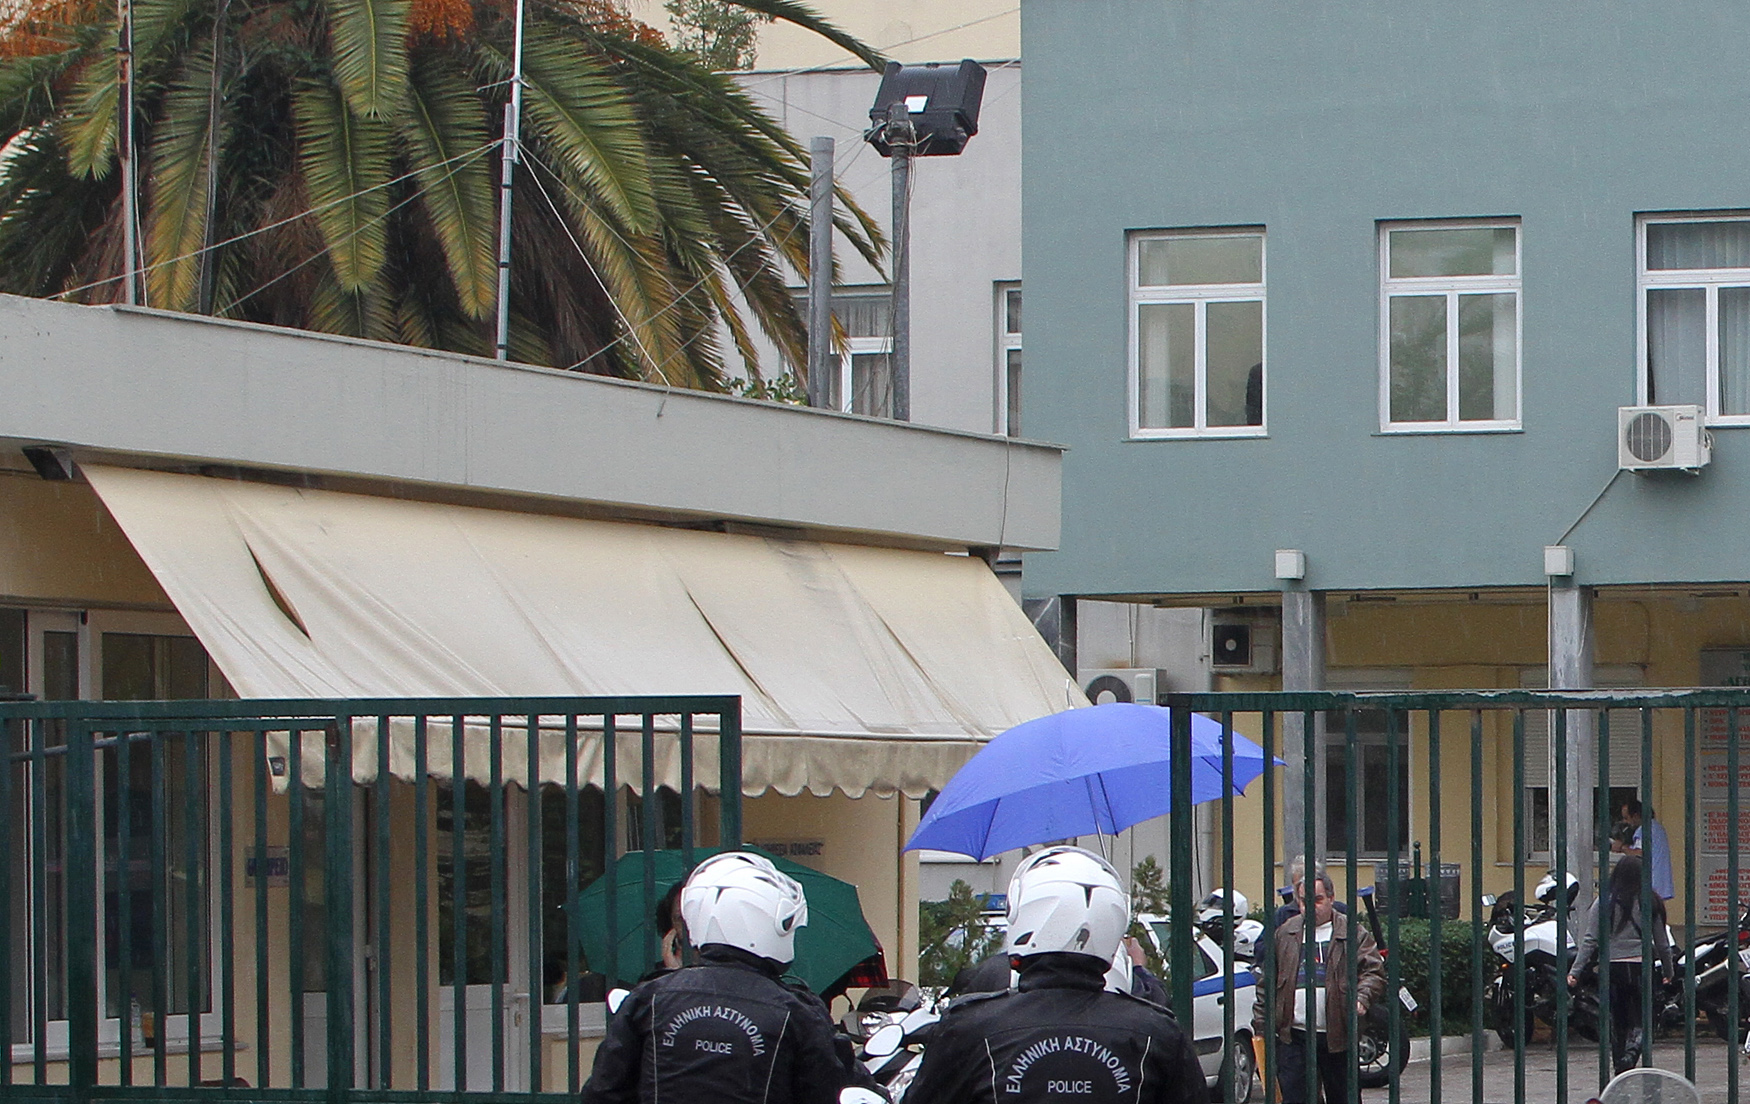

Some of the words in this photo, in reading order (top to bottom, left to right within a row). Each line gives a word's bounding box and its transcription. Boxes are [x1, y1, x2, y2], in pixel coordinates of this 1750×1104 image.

[662, 1005, 711, 1047] ΕΛΛΗΝΙΚΗ
[713, 1006, 766, 1057] ΑΣΤΥΝΟΜΙΑ
[695, 1039, 732, 1054] POLICE
[1006, 1037, 1061, 1093] ΕΛΛΗΝΙΚΗ
[1064, 1036, 1131, 1094] ΑΣΤΥΝΟΜΙΑ
[1047, 1080, 1092, 1094] POLICE
